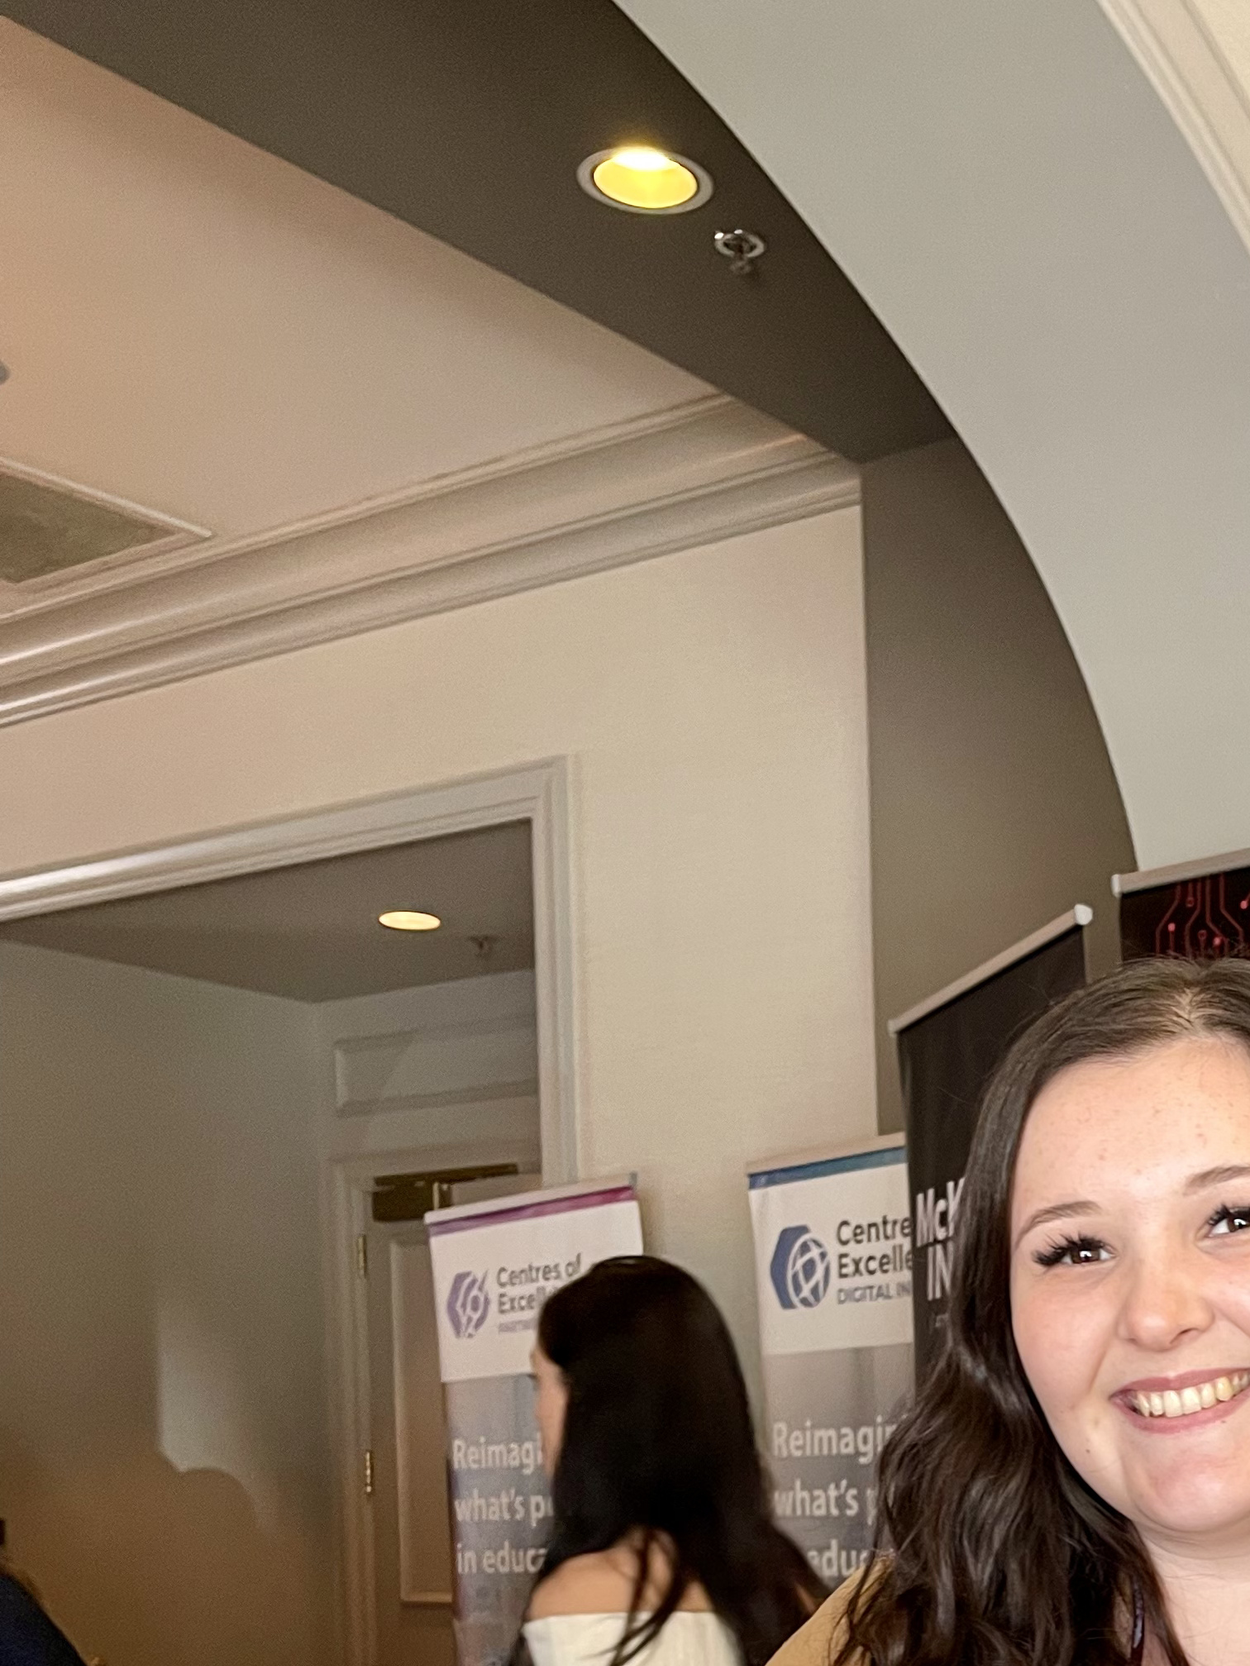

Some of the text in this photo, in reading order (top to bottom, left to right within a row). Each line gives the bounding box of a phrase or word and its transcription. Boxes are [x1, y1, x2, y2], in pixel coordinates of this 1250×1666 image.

[837, 1215, 912, 1246] Centre
[497, 1252, 582, 1288] Centres of
[837, 1283, 893, 1304] DIGITAL
[454, 1487, 526, 1522] what's
[774, 1478, 859, 1517] what's
[457, 1543, 477, 1574] in
